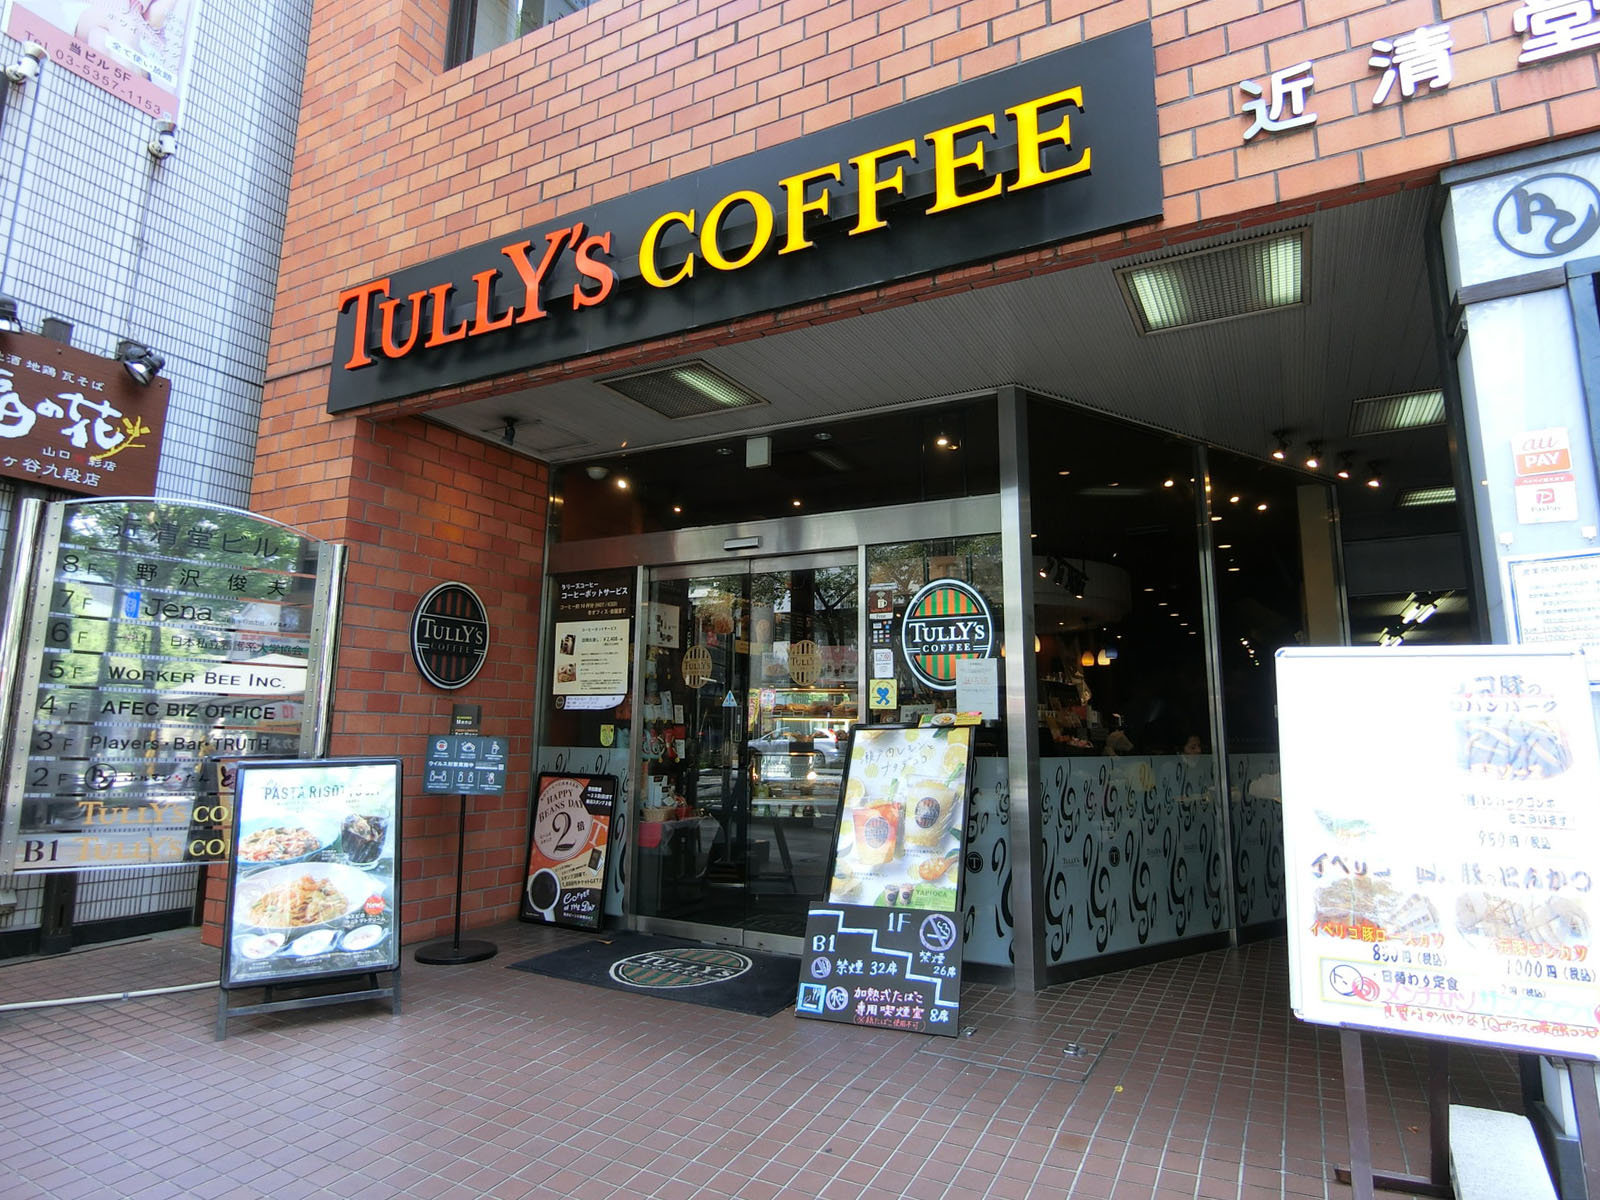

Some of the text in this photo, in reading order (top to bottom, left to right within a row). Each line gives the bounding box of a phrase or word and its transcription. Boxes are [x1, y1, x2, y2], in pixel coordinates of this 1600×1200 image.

[69, 42, 132, 82] 当ビル 5F
[1239, 0, 1600, 141] 近清堂
[55, 50, 161, 115] 03-5357-1153
[338, 85, 1093, 371] TULLY'S COFFEE
[62, 370, 105, 391] 瓦そば
[43, 446, 70, 459] 山口
[1525, 451, 1560, 468] PAY
[113, 516, 279, 558] 近清堂ビル
[561, 582, 599, 590] タリーズコーヒー
[561, 586, 628, 600] コーヒーポットサービス
[145, 598, 213, 621] Jena
[420, 618, 483, 645] TULLY'S
[909, 621, 985, 643] TULLY'S
[922, 643, 971, 653] COFFEE
[108, 666, 200, 684] WORKER
[205, 673, 240, 685] BEE
[249, 674, 286, 688] INC.
[101, 701, 159, 716] AFEC
[166, 703, 198, 718] BIZ
[205, 704, 275, 719] OFFICE
[547, 788, 574, 805] HAPPY
[539, 799, 565, 824] BEANS
[552, 812, 577, 854] 2
[577, 821, 585, 832] 倍
[24, 839, 59, 862] B1
[888, 913, 911, 932] 1F
[812, 935, 836, 952] B1
[641, 955, 735, 977] TULLY'S
[836, 959, 898, 976] 禁煙 32席
[919, 951, 946, 965] 禁煙
[933, 966, 957, 978] 26席
[1381, 968, 1460, 991] 日替わり定食
[854, 987, 924, 1004] 加熱式たばこ
[929, 1009, 949, 1023] 8席
